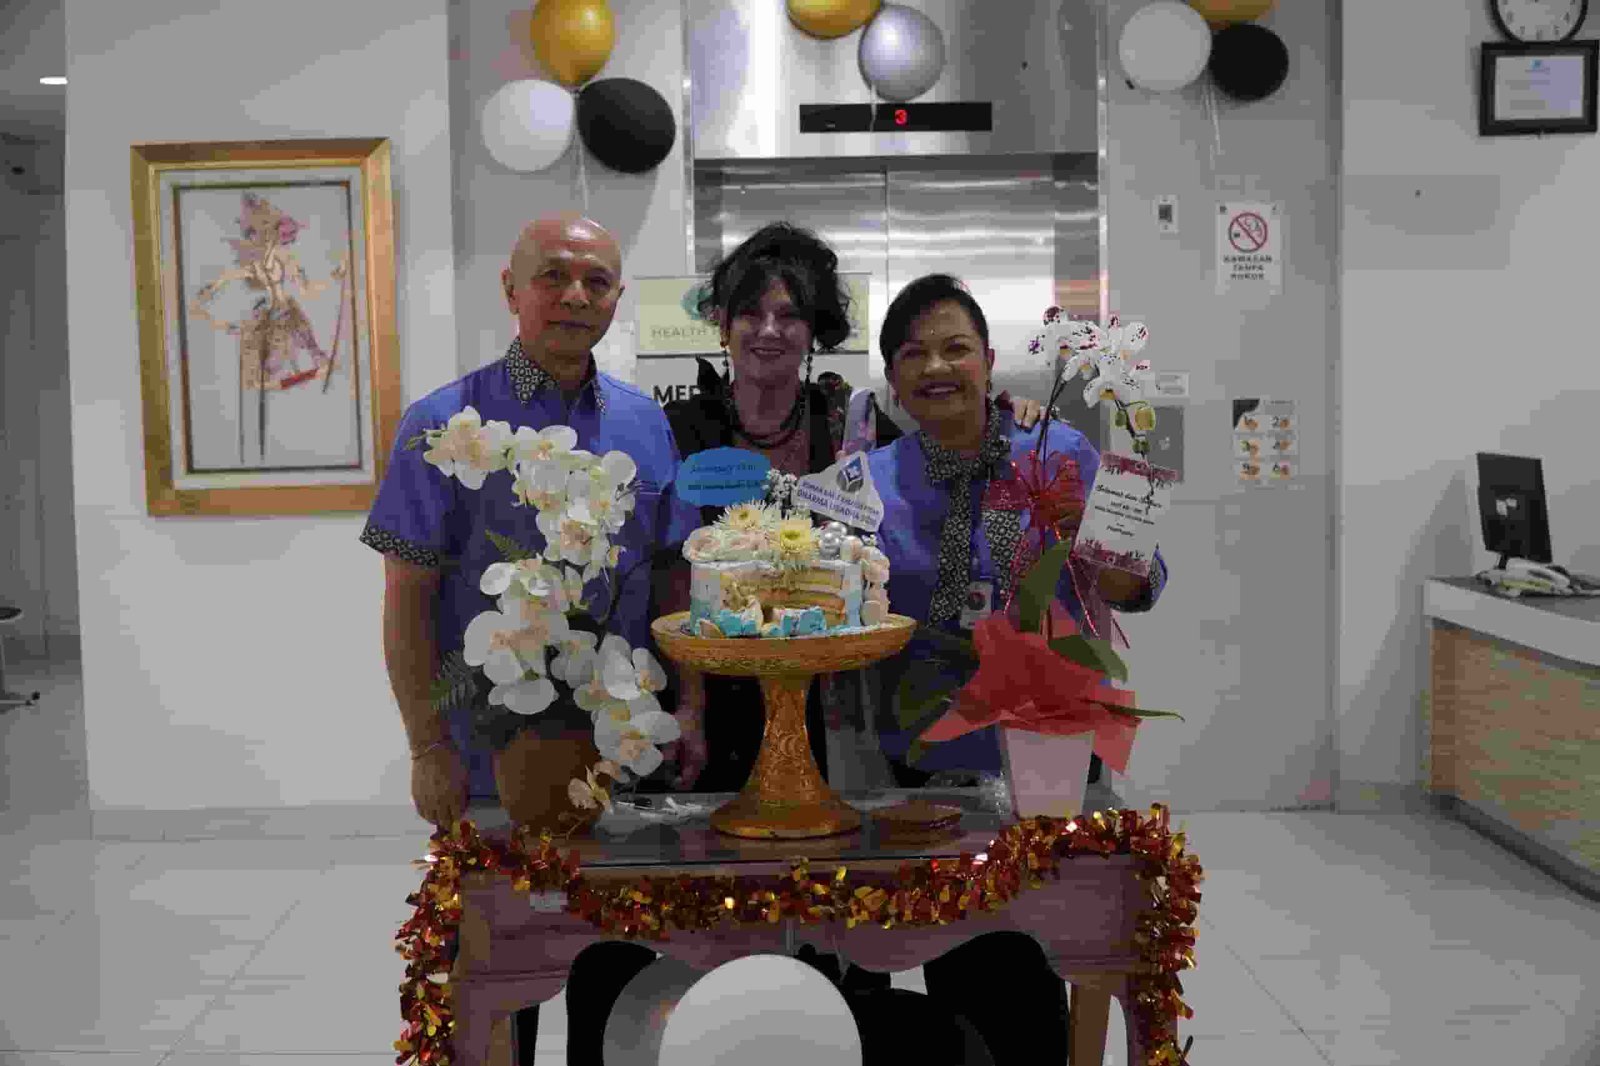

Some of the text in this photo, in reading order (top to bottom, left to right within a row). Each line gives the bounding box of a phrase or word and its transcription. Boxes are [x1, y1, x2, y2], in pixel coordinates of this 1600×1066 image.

[895, 109, 907, 125] 3
[1223, 254, 1272, 263] KAWASAN
[651, 325, 707, 338] HEALTH
